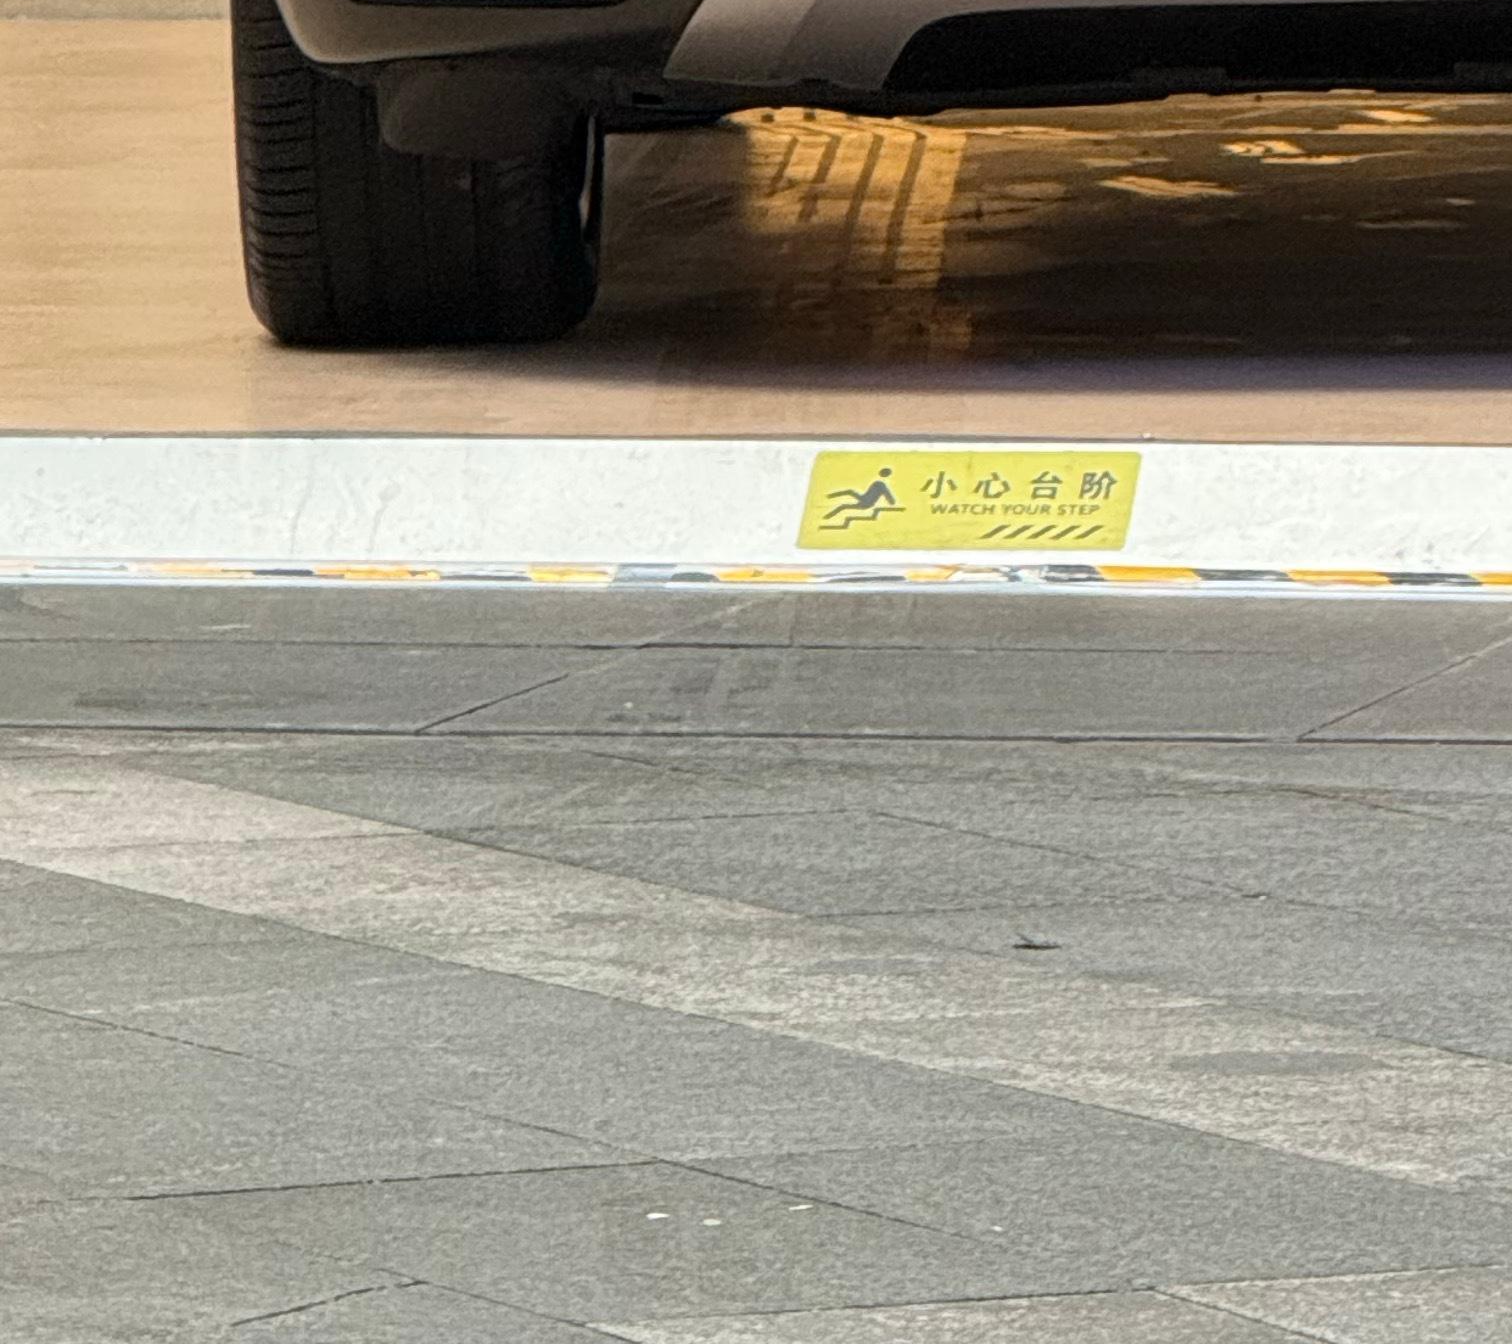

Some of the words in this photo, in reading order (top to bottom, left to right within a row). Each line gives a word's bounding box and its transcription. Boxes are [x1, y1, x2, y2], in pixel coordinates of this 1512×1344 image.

[920, 470, 1118, 500] 小心台阶
[931, 503, 995, 516] WATCH
[1003, 503, 1050, 516] YOUR
[1057, 503, 1101, 516] STEP
